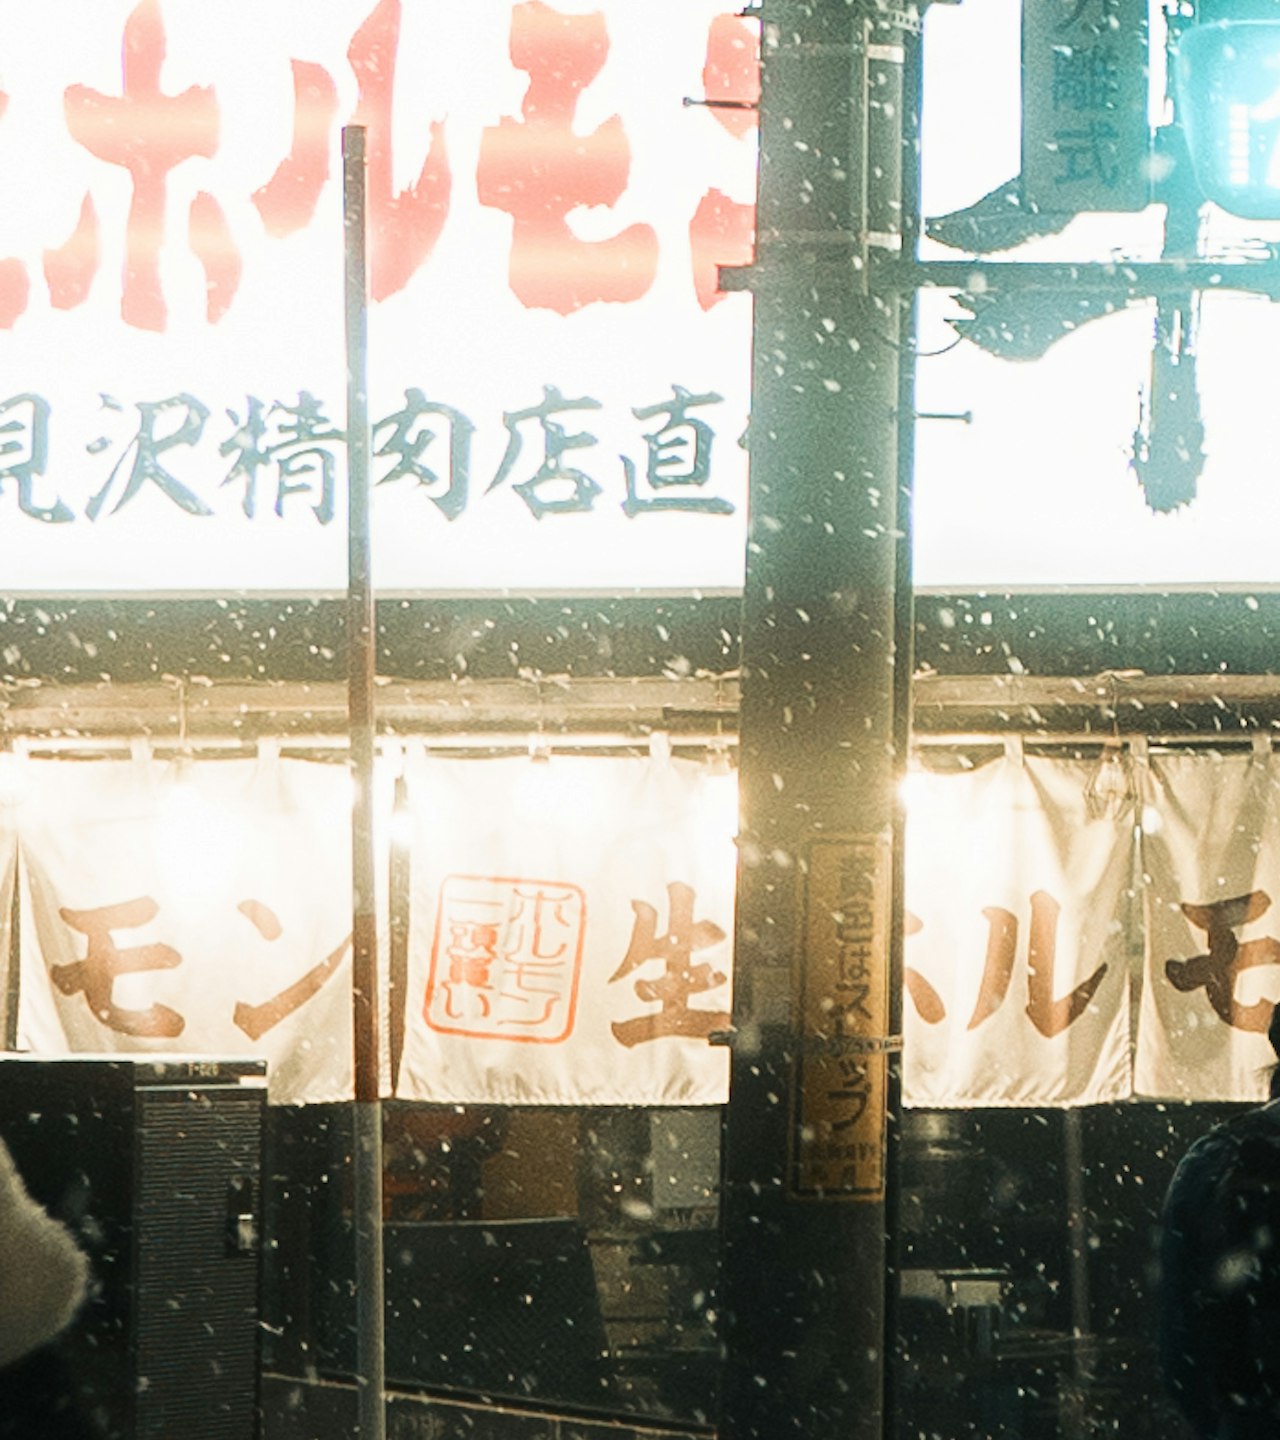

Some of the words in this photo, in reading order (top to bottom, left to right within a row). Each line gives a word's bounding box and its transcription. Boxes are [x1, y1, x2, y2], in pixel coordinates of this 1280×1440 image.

[0, 382, 752, 525] 見沢精肉店直
